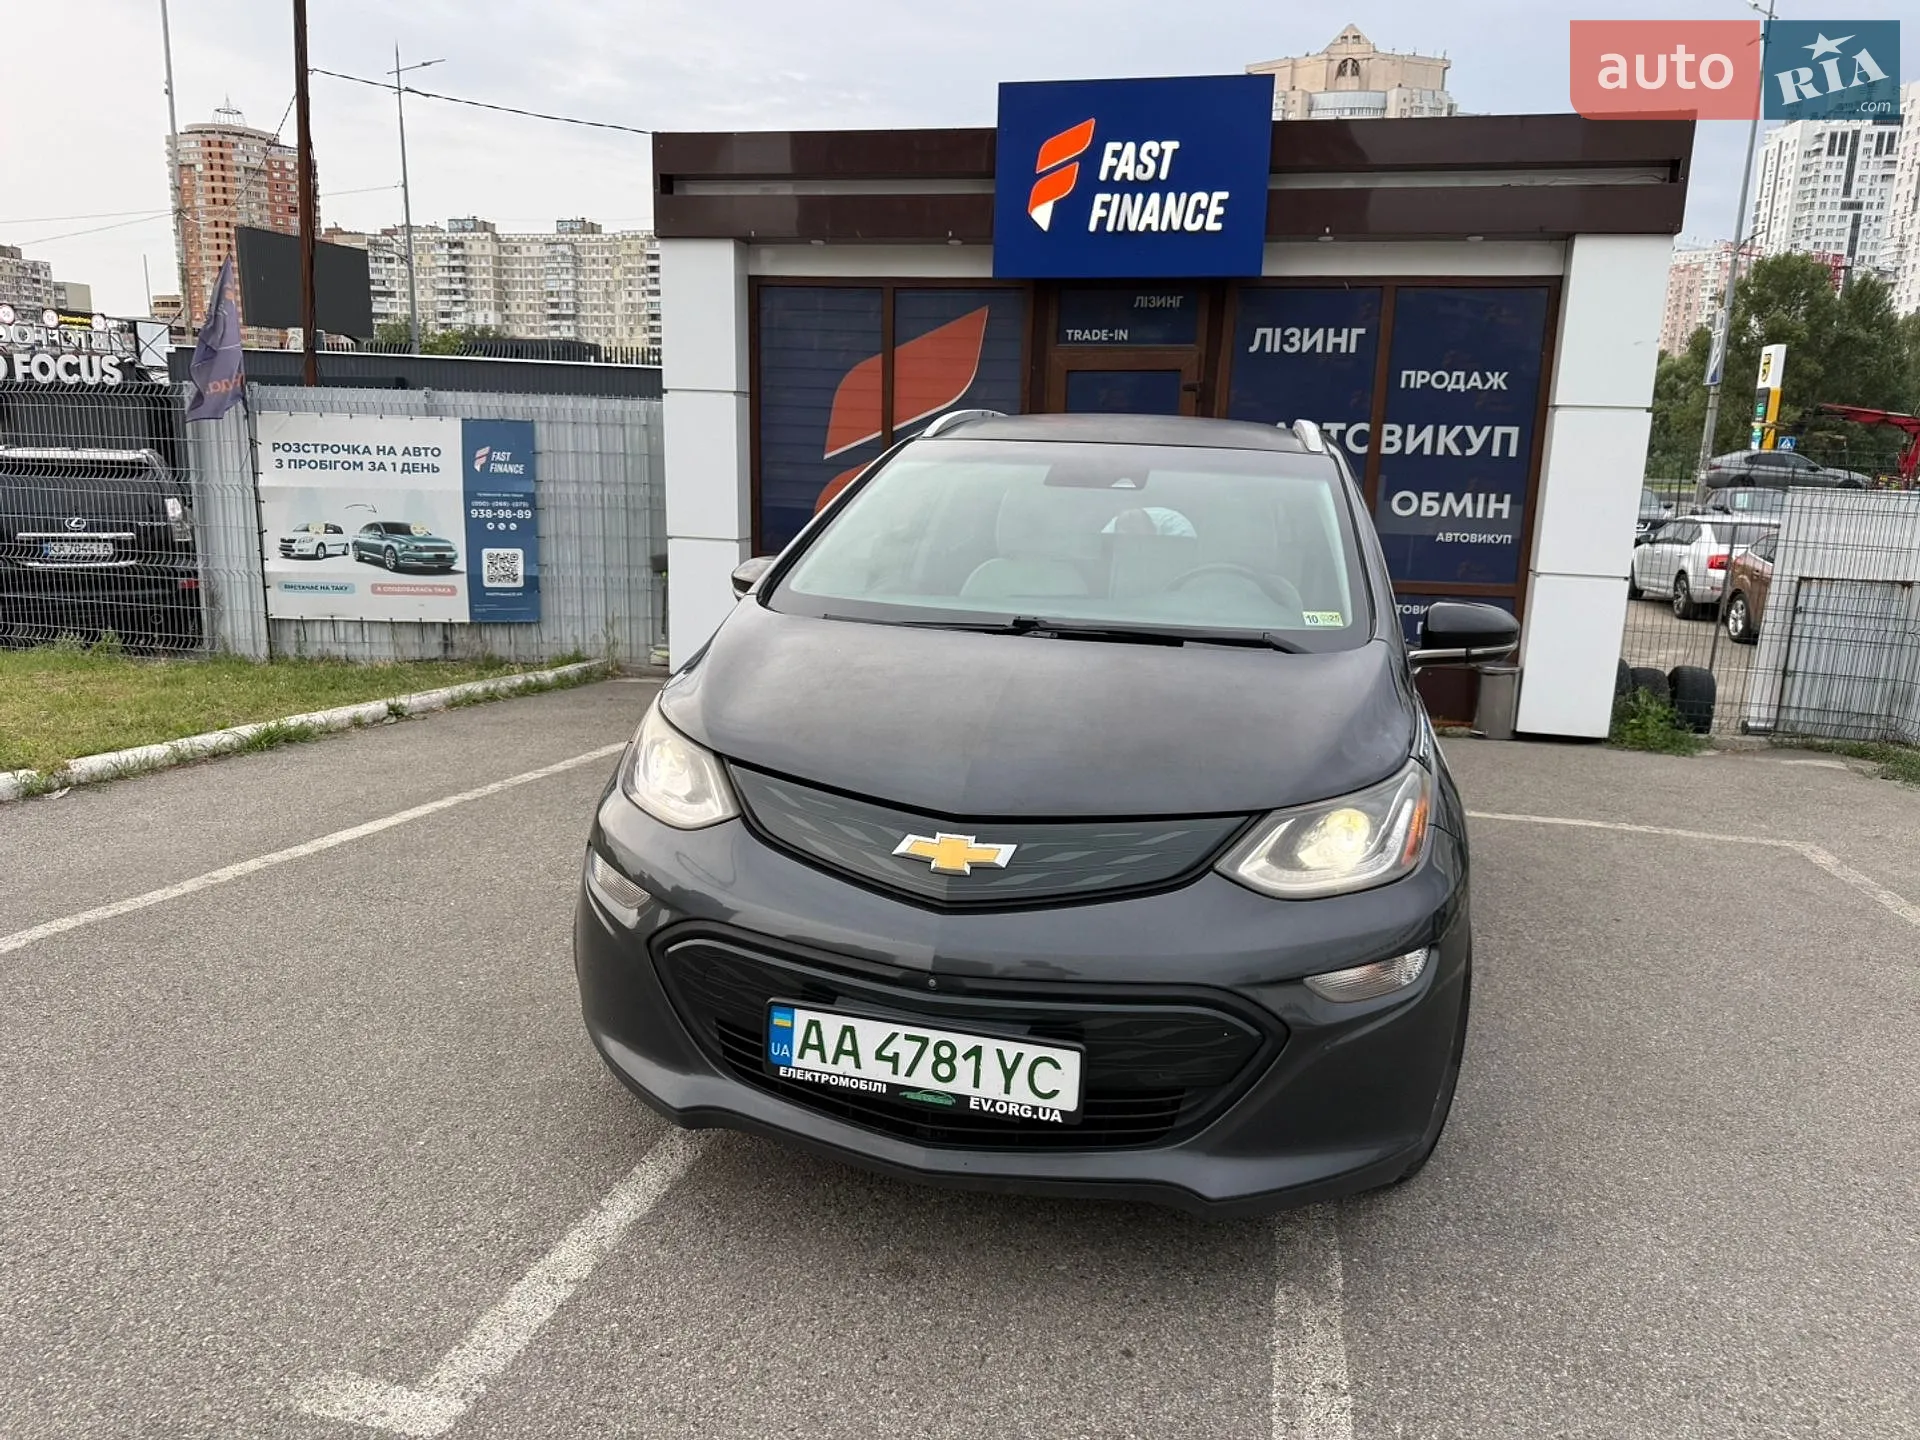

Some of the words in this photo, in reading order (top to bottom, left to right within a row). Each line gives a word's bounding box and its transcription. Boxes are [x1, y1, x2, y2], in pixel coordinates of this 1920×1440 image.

[1098, 140, 1181, 182] FAST
[1087, 190, 1230, 233] FINANCE
[1133, 295, 1184, 309] ЛІЗИНГ
[1065, 329, 1129, 342] TRADE-IN
[1248, 327, 1367, 354] ЛІЗИНГ
[13, 352, 124, 386] FOCUS
[1400, 370, 1510, 393] ПРОДАЖ
[1276, 421, 1521, 458] ТОВИКУП
[271, 442, 373, 456] РОЗСТРОЧКА
[376, 445, 398, 457] НА
[401, 446, 442, 458] АВТО
[491, 451, 513, 462] FAST
[287, 459, 364, 472] ПРОБІГОМ
[367, 461, 388, 473] ЗА
[391, 462, 397, 473] 1
[400, 462, 441, 475] ДЕНЬ
[488, 462, 526, 475] FINANCE
[470, 508, 532, 519] 938-98-89
[1390, 490, 1512, 520] ОБМІН
[1435, 532, 1513, 545] АВТОВИКУП
[1305, 614, 1319, 624] 10
[771, 1042, 790, 1058] UA
[797, 1018, 862, 1070] AA
[874, 1031, 983, 1090] 4781
[996, 1048, 1063, 1100] YC
[779, 1066, 887, 1094] ЕЛЕКТРОМОБІЛІ
[969, 1096, 1064, 1123] EV.ORG.UA
